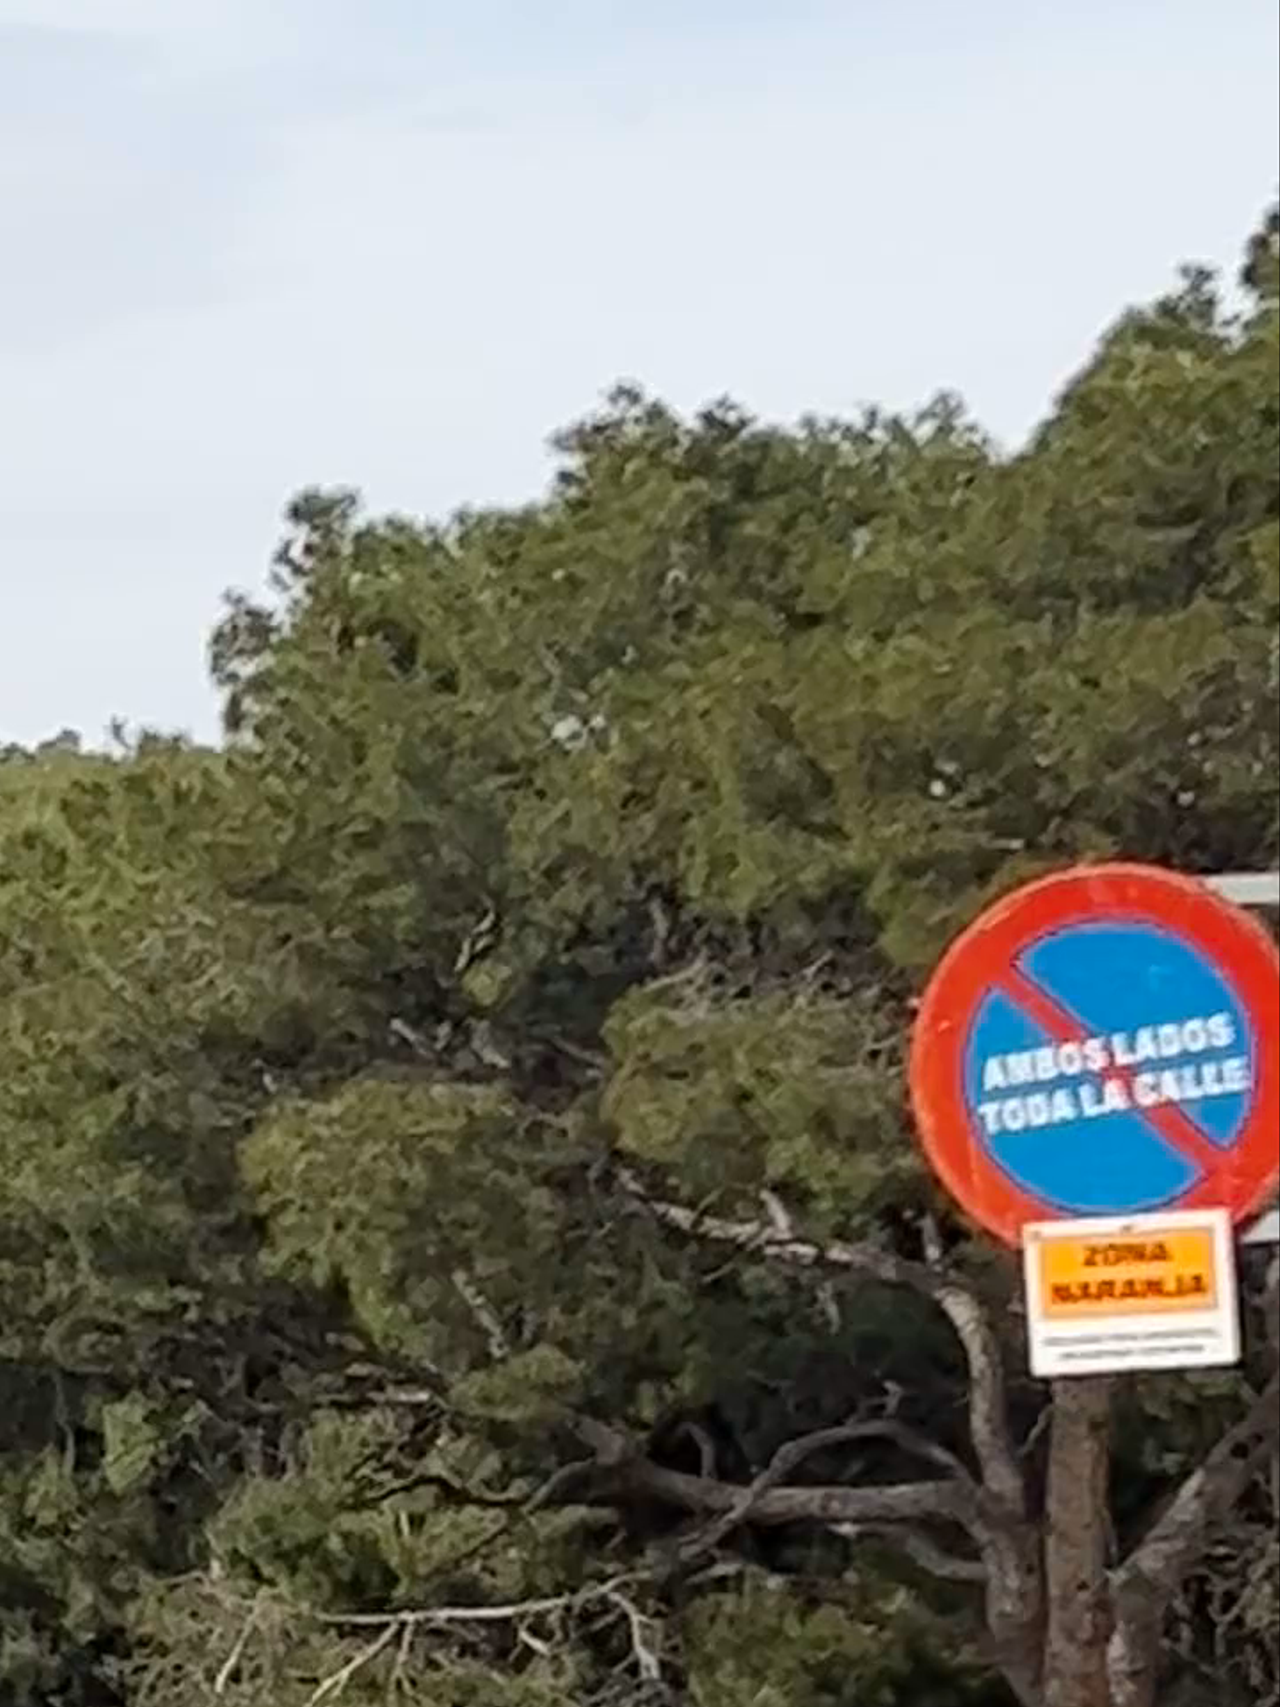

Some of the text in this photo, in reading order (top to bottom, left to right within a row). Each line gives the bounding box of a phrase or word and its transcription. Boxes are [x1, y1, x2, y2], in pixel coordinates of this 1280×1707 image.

[983, 1012, 1235, 1091] AMBOS LADOS
[979, 1056, 1251, 1135] TODA LA CALLE
[1082, 1241, 1170, 1267] ZONA
[1051, 1274, 1207, 1304] NARANJA
